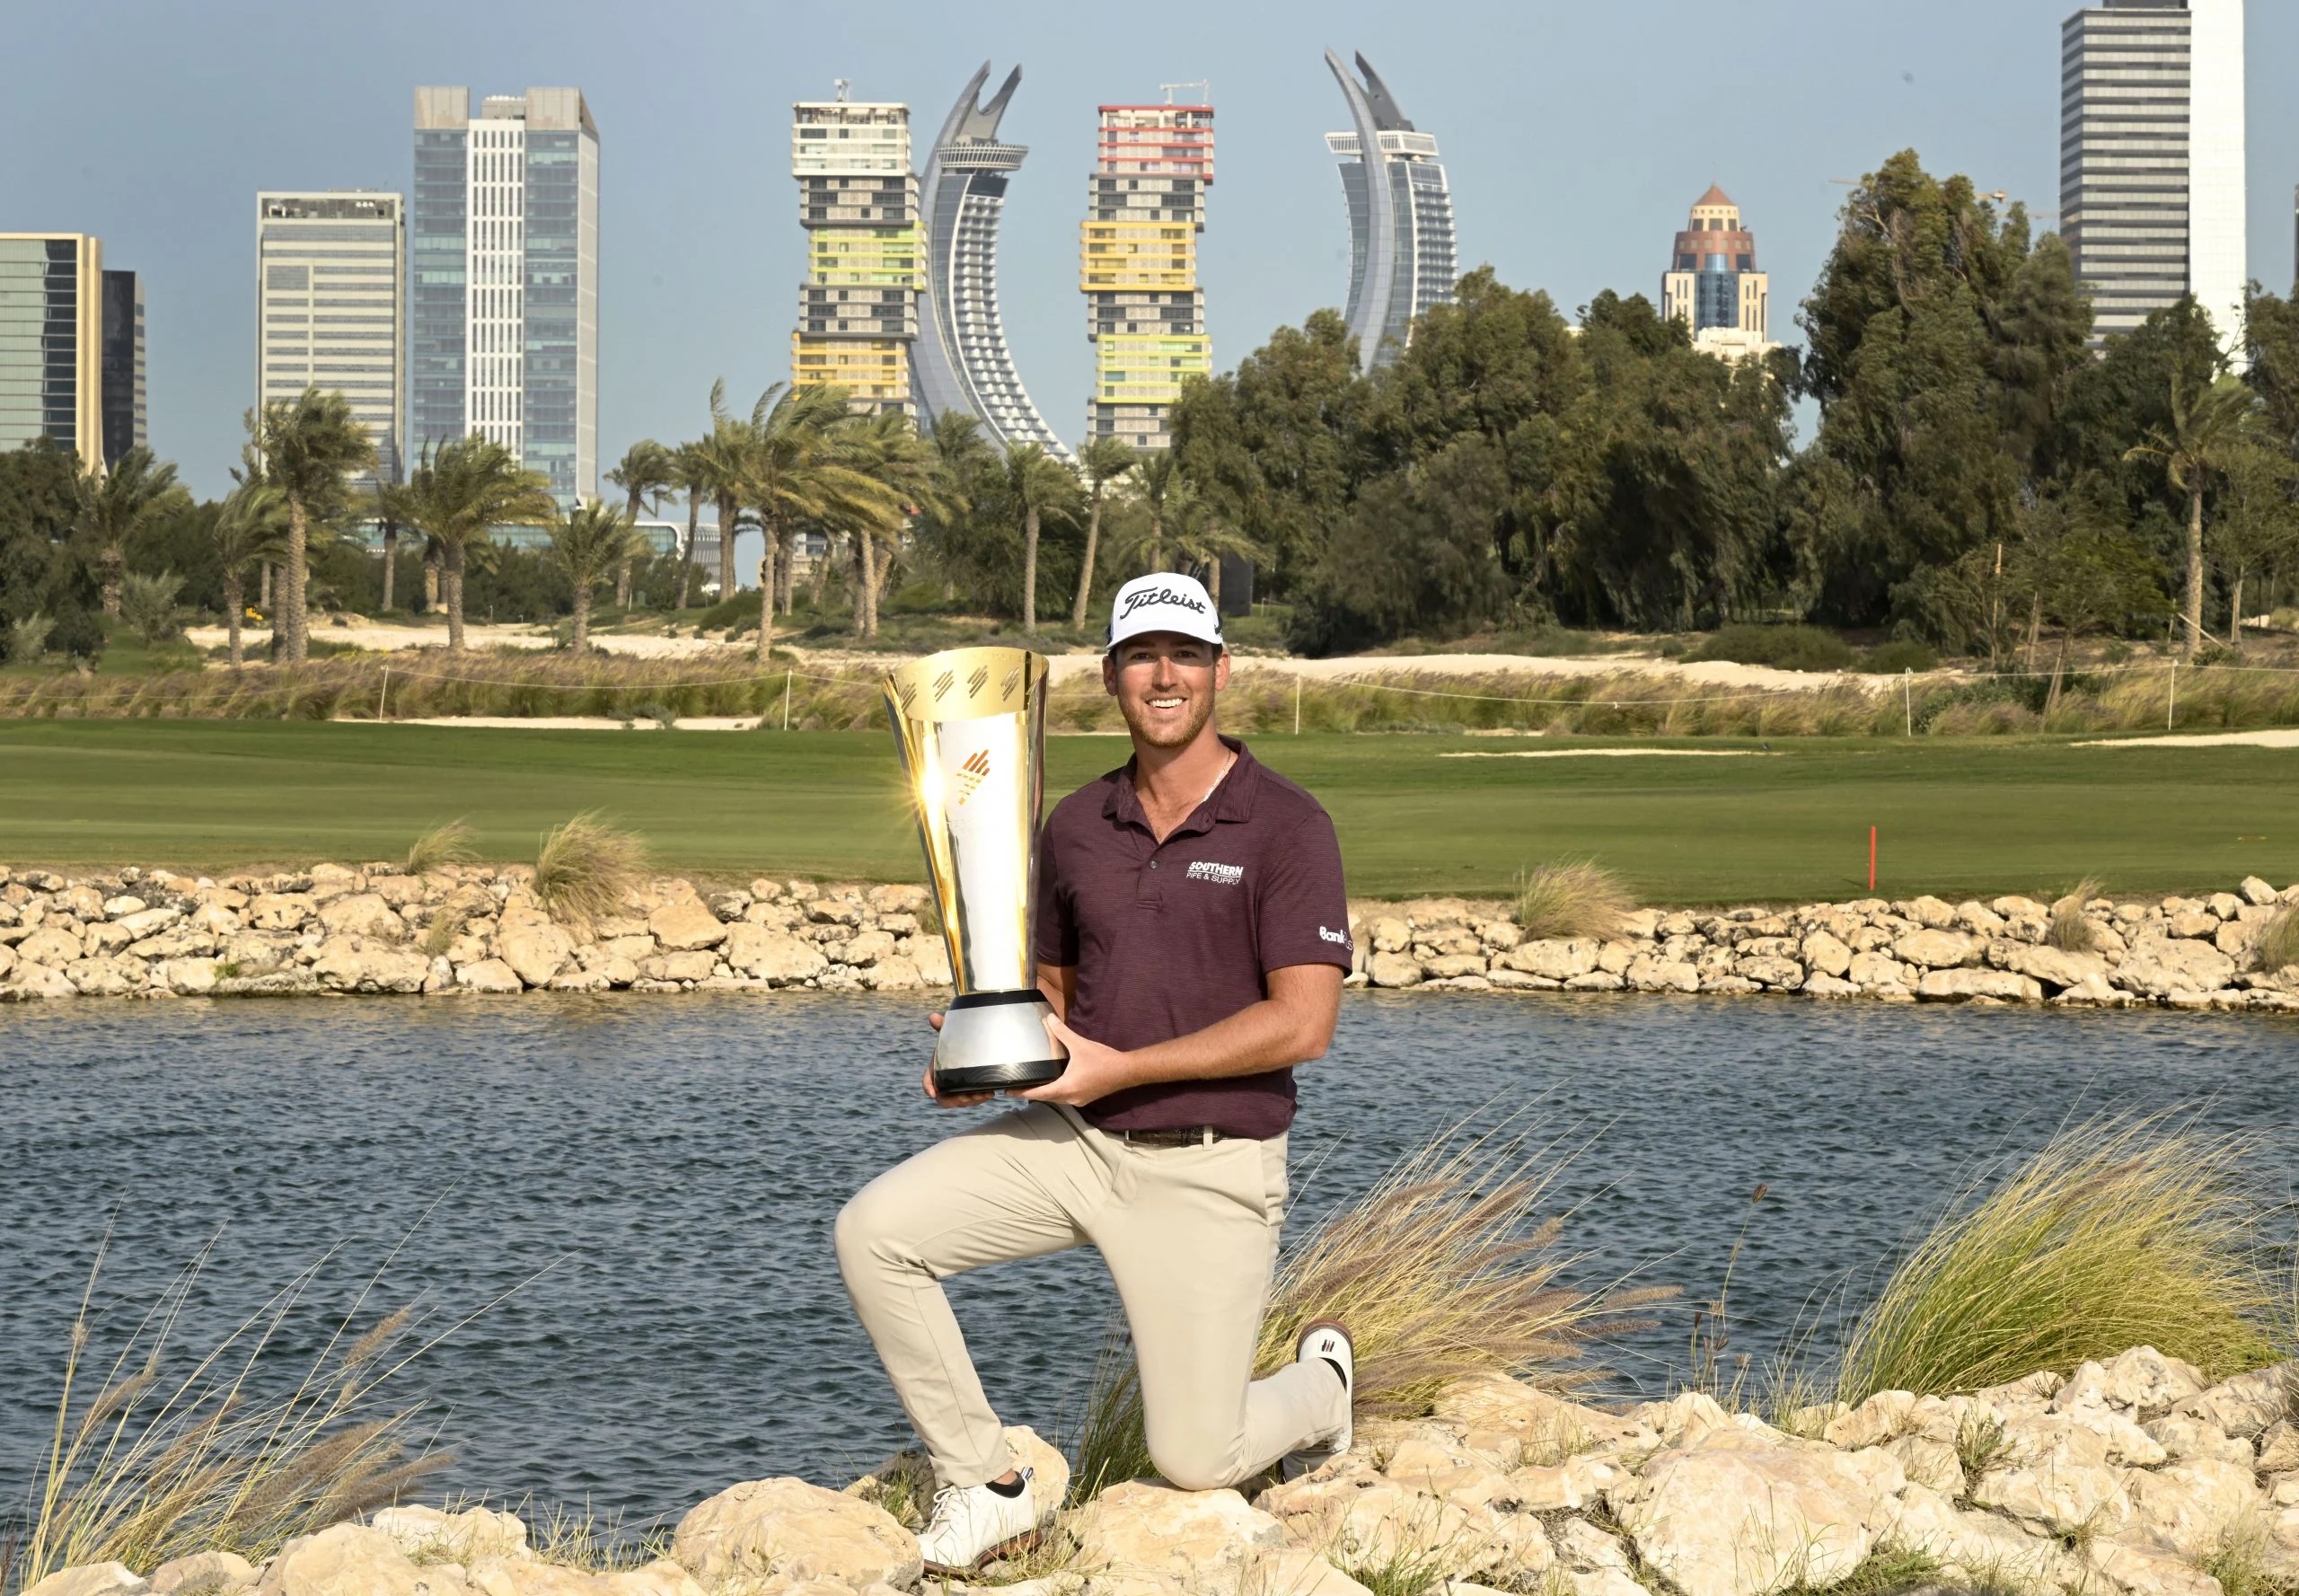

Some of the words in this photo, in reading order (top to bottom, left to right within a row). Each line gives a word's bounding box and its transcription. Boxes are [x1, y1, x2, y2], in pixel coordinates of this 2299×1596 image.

[1120, 586, 1206, 620] Titleist
[1188, 861, 1244, 876] SOUTHERN
[1211, 875, 1240, 885] SUPPLY
